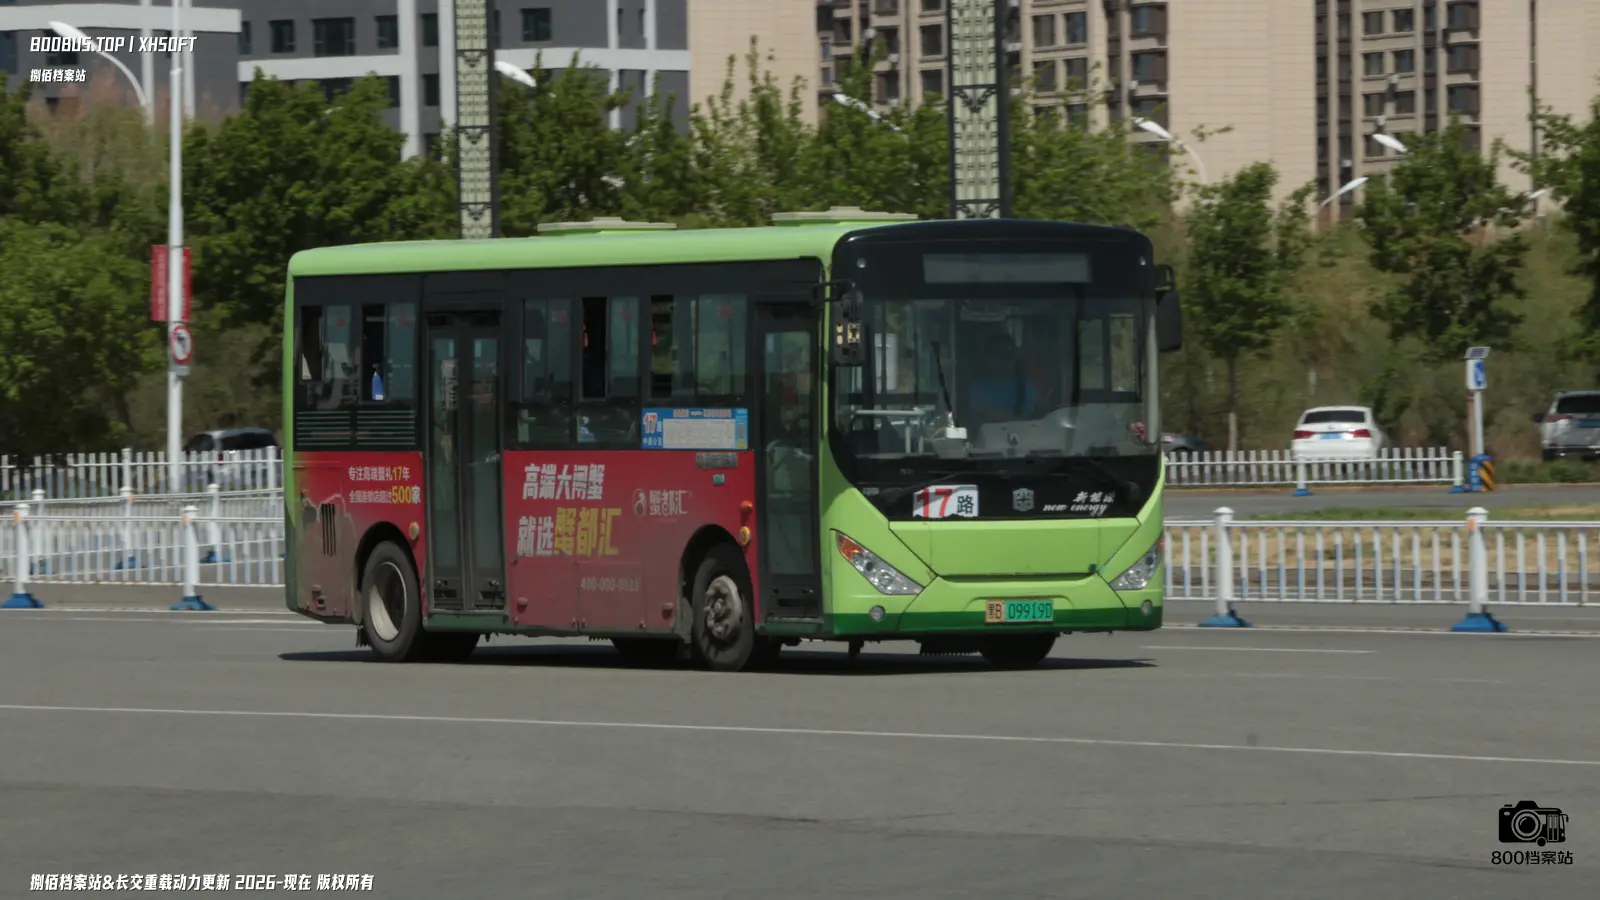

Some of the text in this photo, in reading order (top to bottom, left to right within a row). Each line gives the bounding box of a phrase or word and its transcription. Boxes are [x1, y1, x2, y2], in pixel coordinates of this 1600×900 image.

[522, 463, 605, 500] 高端大闸蟹
[1042, 504, 1108, 517] new energy
[516, 506, 622, 557] 就选蟹都汇
